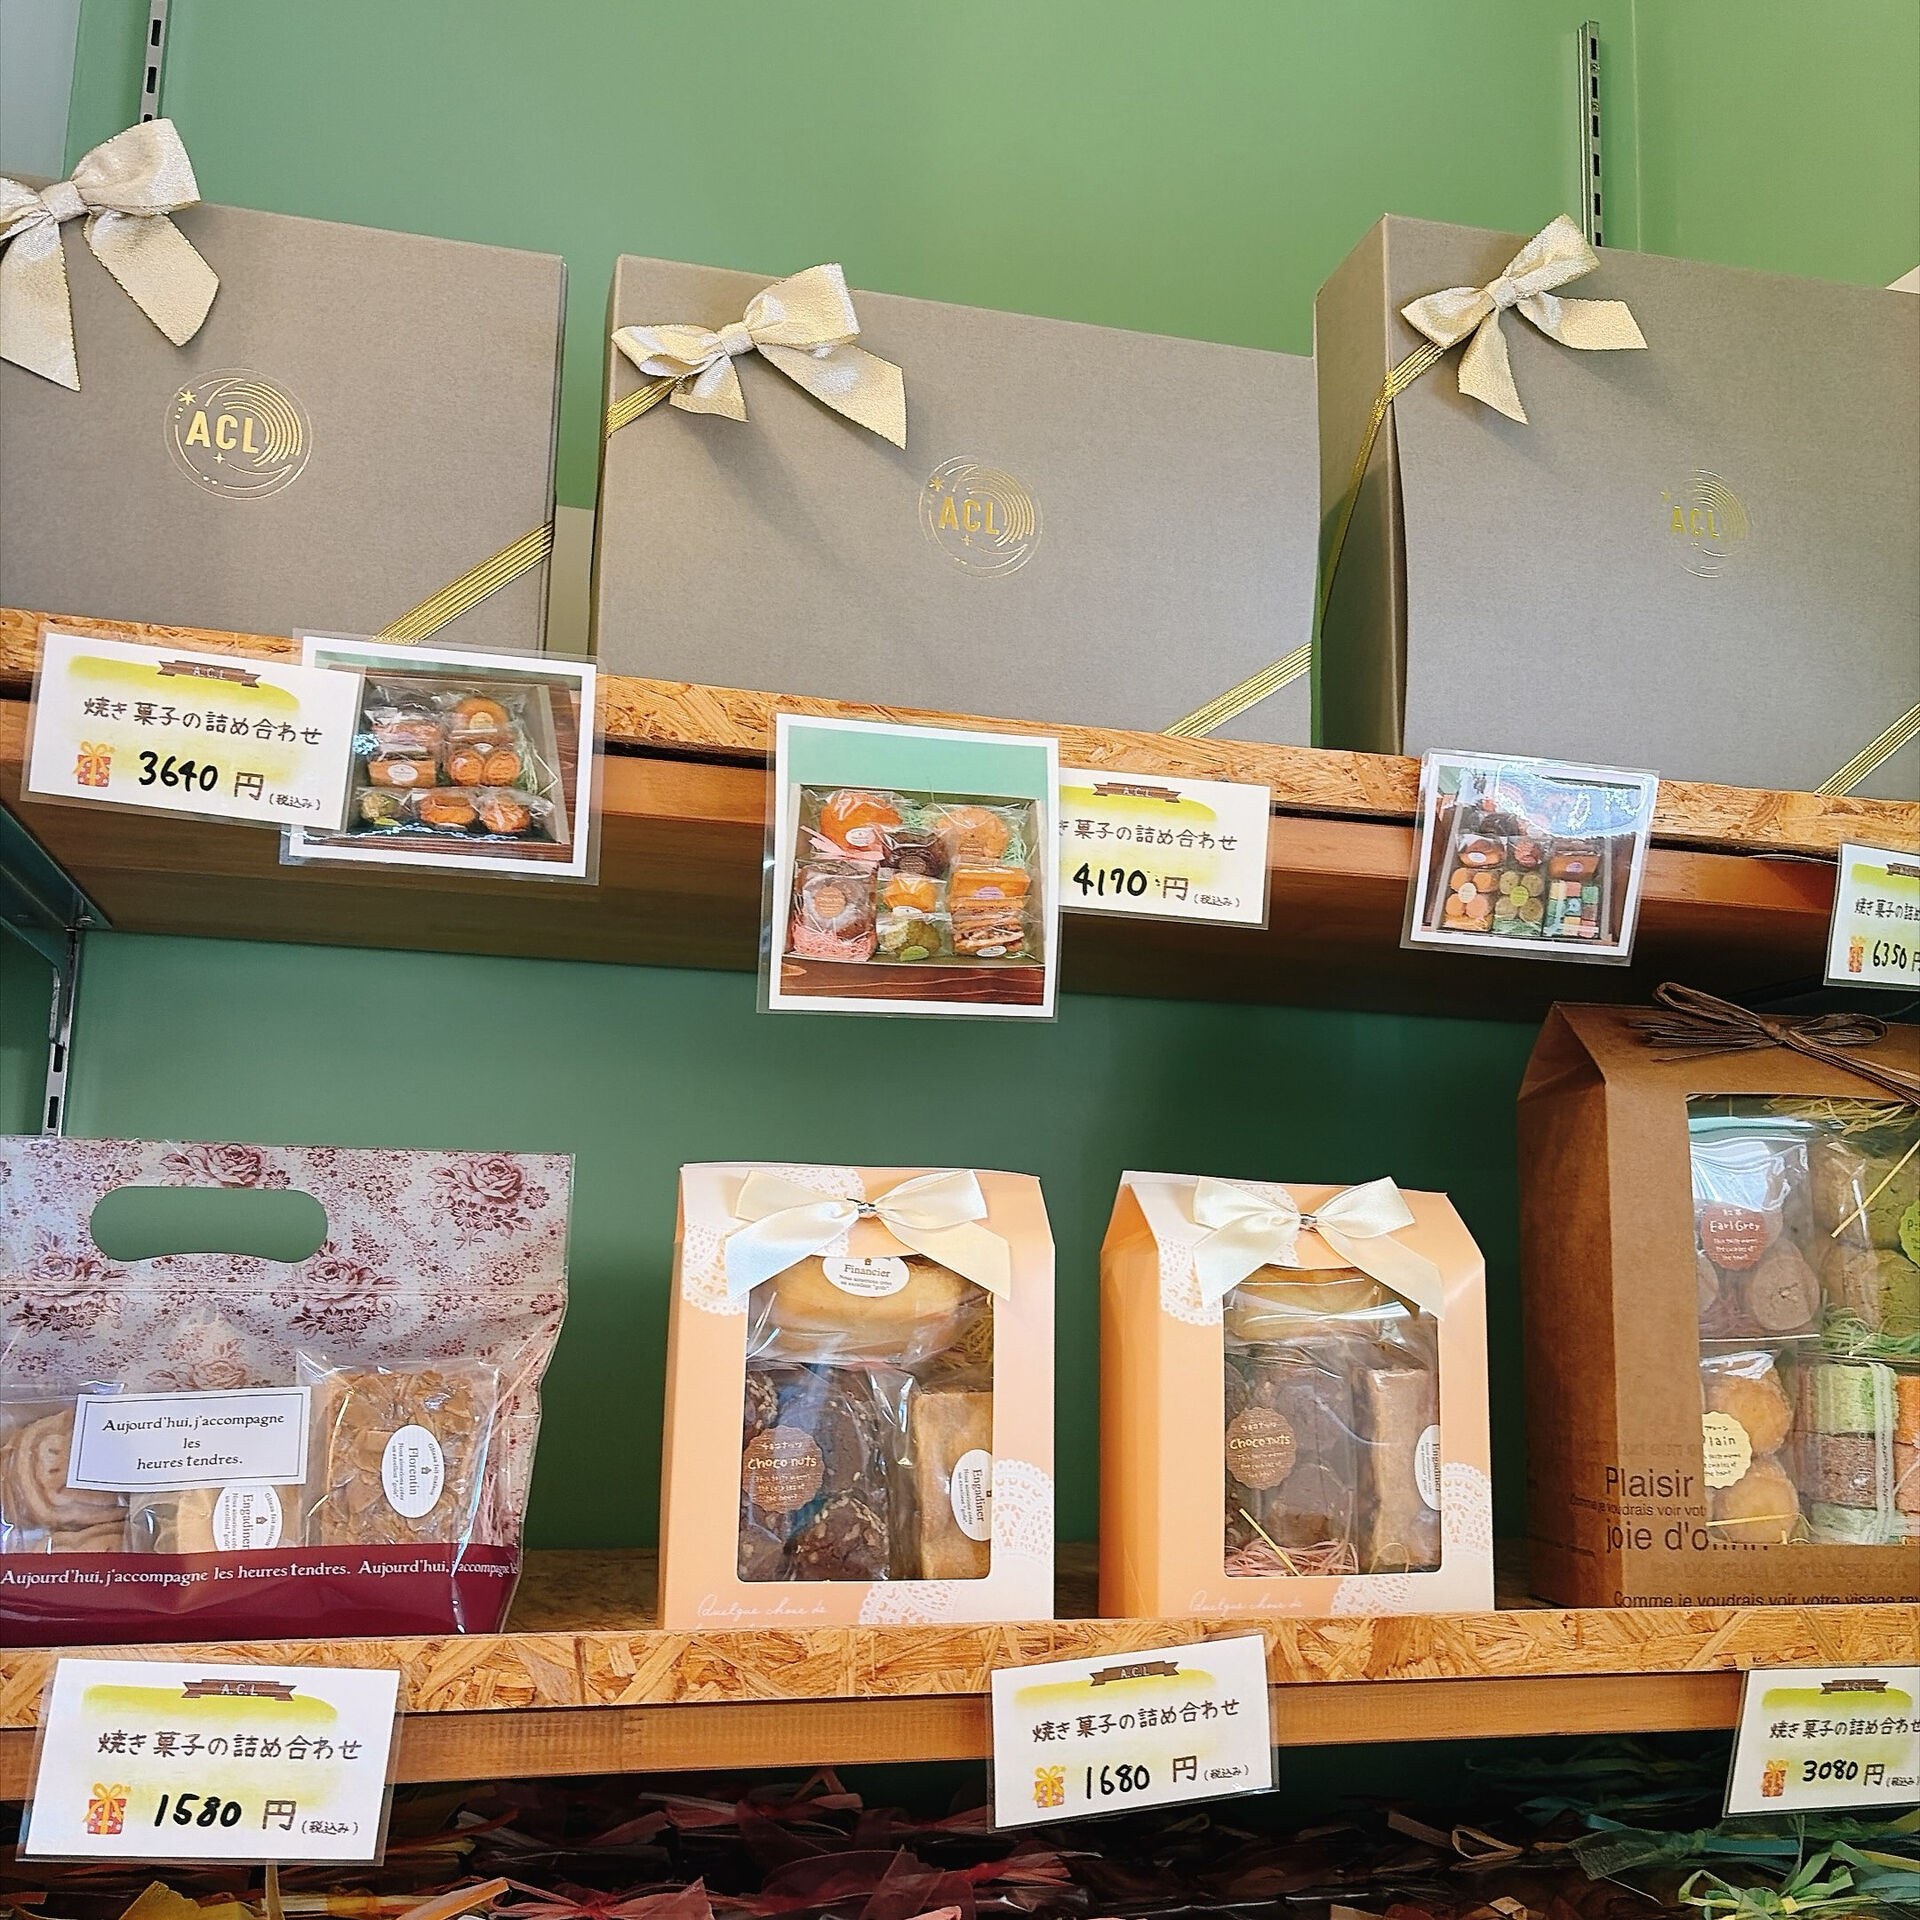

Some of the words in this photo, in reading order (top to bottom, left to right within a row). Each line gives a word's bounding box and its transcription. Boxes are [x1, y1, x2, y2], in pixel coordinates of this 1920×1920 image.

[185, 410, 260, 454] ACL
[939, 496, 1000, 535] ACL
[1670, 505, 1720, 539] ACL
[83, 696, 323, 746] 焼き菓子の詰め合わせ
[138, 751, 218, 792] 3640
[233, 771, 264, 801] 円
[1162, 876, 1189, 902] 円
[1872, 939, 1908, 970] 6350
[1709, 1219, 1734, 1234] Earl
[1734, 1219, 1760, 1233] Grey
[843, 1263, 892, 1279] Financier
[192, 1414, 286, 1432] j'accompagne
[183, 1437, 201, 1449] les
[136, 1457, 184, 1470] heures
[186, 1453, 243, 1467] tendres.
[408, 1447, 420, 1496] Florentin
[791, 1454, 817, 1468] nuts
[971, 1468, 985, 1522] Engadiner
[1605, 1466, 1693, 1498] Plaisir
[239, 1494, 254, 1549] Engadiner
[1656, 1503, 1682, 1517] voir
[1605, 1519, 1652, 1554] joie
[103, 1568, 208, 1587] j'accompagne
[213, 1565, 234, 1580] les
[237, 1562, 288, 1579] heures
[290, 1559, 351, 1577] tendres.
[1614, 1590, 1674, 1608] Comme
[1697, 1593, 1765, 1606] voudrais
[1032, 1698, 1241, 1743] 焼き菓子の詰め合わせ
[97, 1729, 363, 1761] 焼き菓子の詰め合わせ
[1085, 1764, 1151, 1800] 1680
[1171, 1755, 1198, 1784] 円
[1802, 1759, 1859, 1783] 3080
[1863, 1763, 1885, 1787] 円
[154, 1793, 242, 1829] 1580
[261, 1800, 297, 1832] 円
